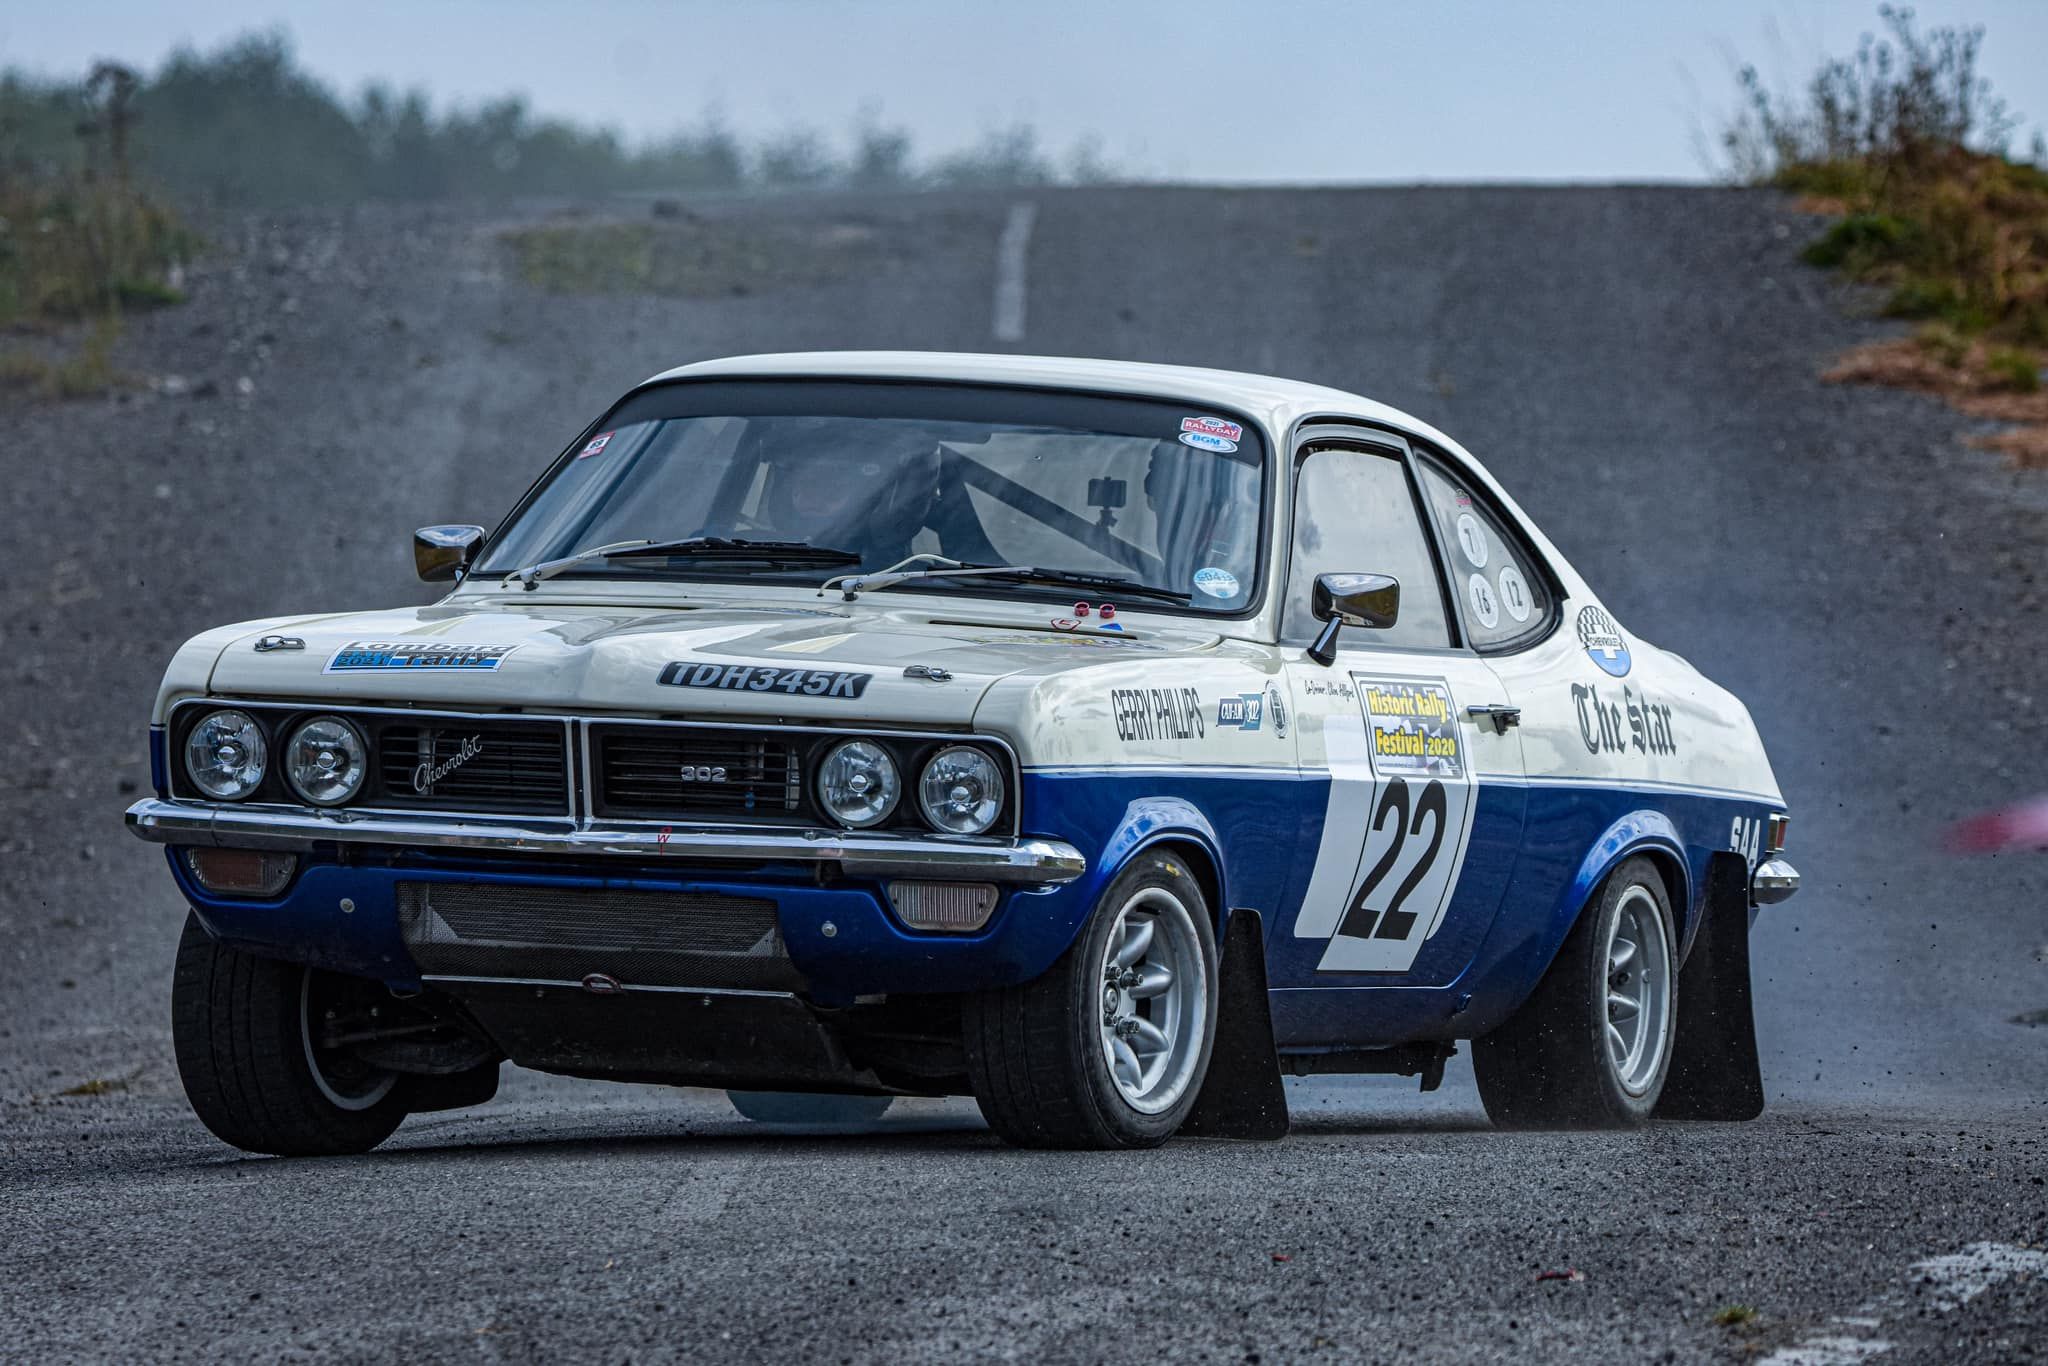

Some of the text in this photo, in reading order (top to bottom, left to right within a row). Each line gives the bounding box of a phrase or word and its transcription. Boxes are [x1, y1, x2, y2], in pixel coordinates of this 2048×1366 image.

[1185, 421, 1238, 437] RALLYDAY
[1192, 434, 1220, 446] BGM
[1475, 587, 1492, 614] 16
[1506, 580, 1523, 608] 12
[405, 651, 491, 666] rally
[670, 662, 864, 698] TDH345K
[1111, 687, 1205, 741] GERRY PHILLIPS
[1366, 687, 1415, 716] Historic
[1415, 690, 1448, 724] Rally
[1571, 682, 1677, 756] The Star
[1375, 726, 1456, 757] Festival 2020
[414, 734, 482, 792] Chevrolet
[681, 766, 727, 782] 302
[1337, 776, 1447, 941] 22
